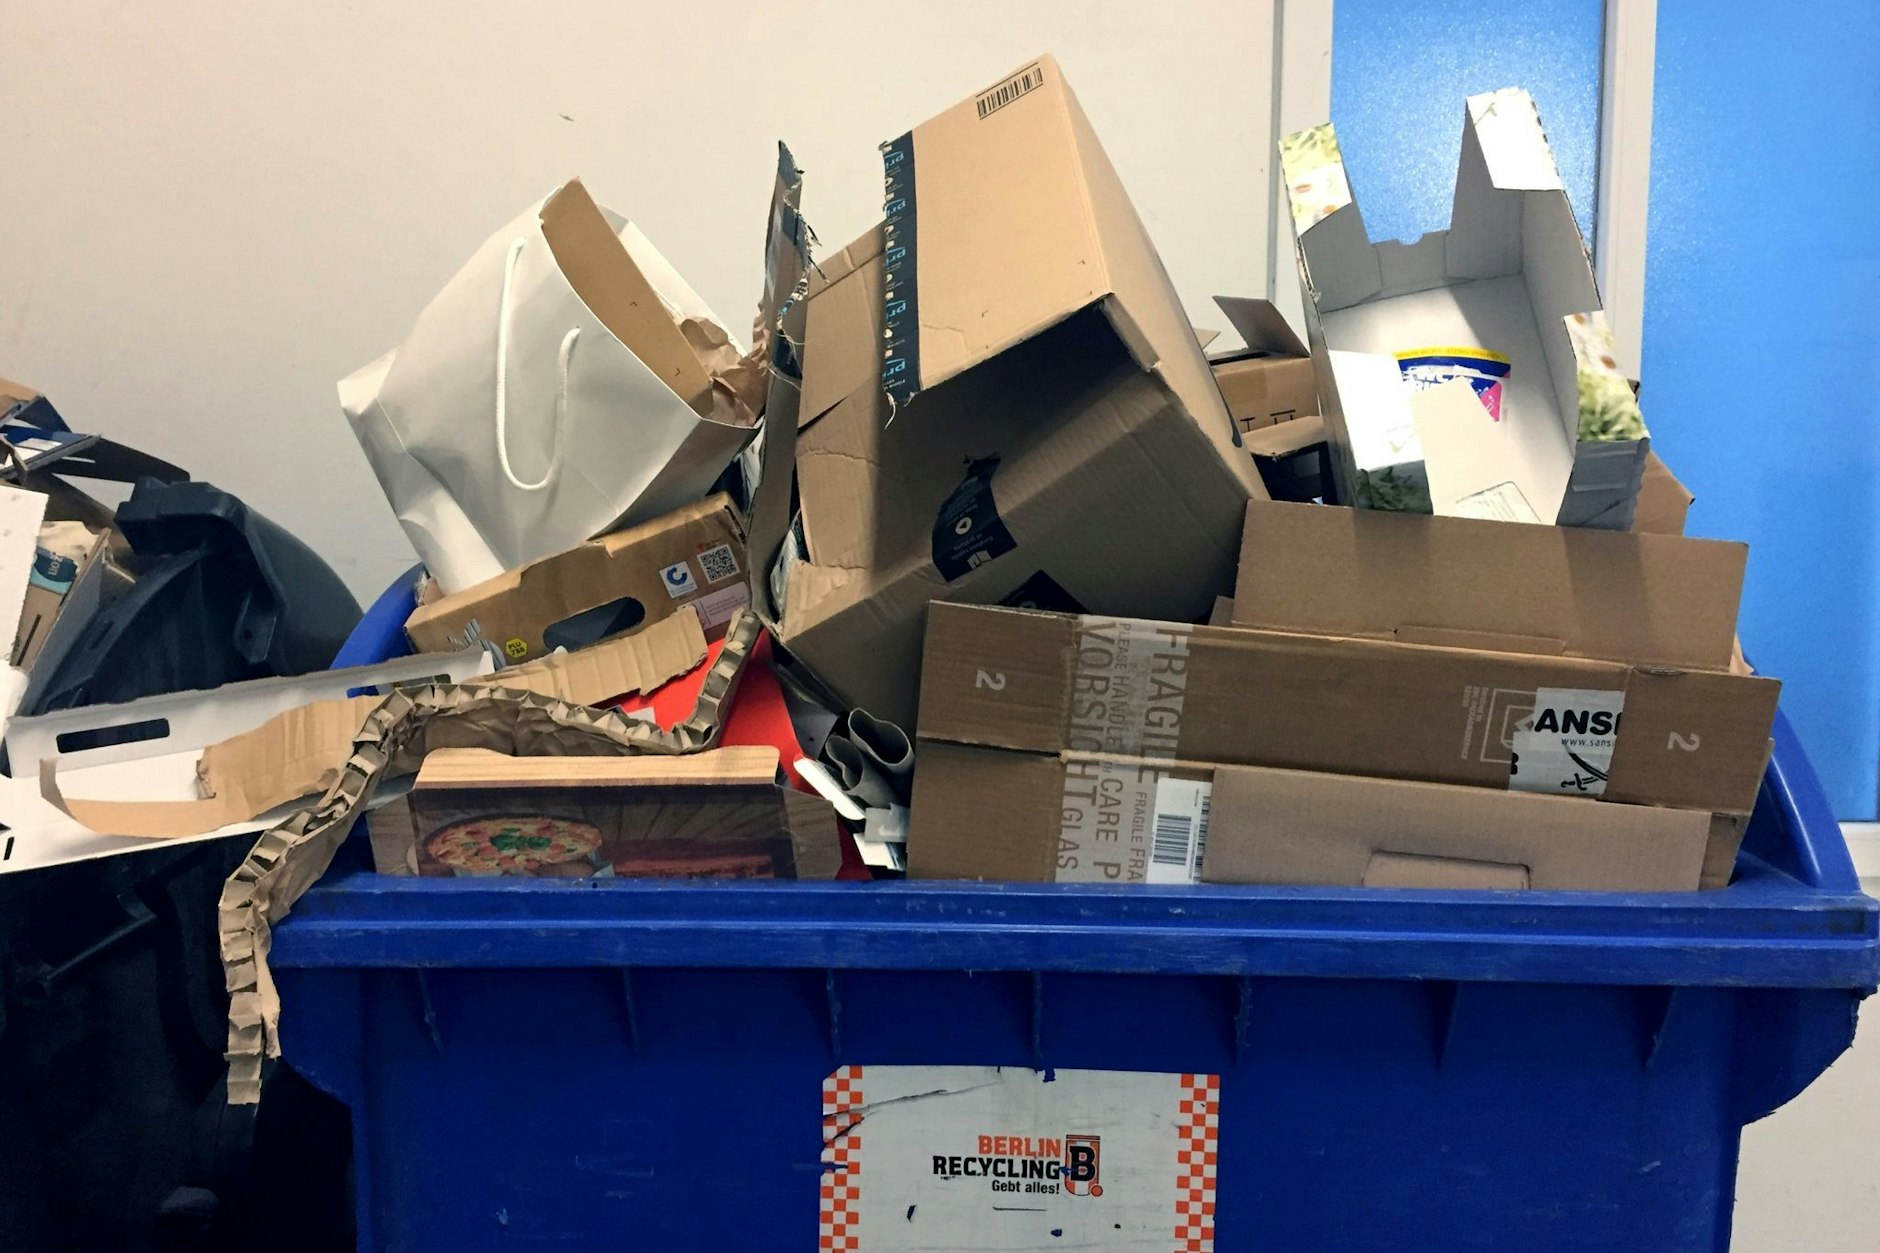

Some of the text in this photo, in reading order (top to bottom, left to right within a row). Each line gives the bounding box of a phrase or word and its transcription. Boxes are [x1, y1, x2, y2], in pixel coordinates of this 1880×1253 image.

[1114, 622, 1132, 670] PLEASE
[975, 669, 1006, 690] 2
[1105, 675, 1129, 746] HANDLE
[1667, 731, 1700, 751] 2
[1095, 777, 1124, 842] CARE
[1130, 791, 1148, 843] FRAGILE
[1057, 807, 1084, 869] GLAS
[1126, 847, 1146, 881] FRA
[978, 1135, 1061, 1158] BERLIN
[1069, 1145, 1096, 1182] B
[932, 1155, 1060, 1180] RECYCLING
[992, 1180, 1060, 1194] Gebt alles!
